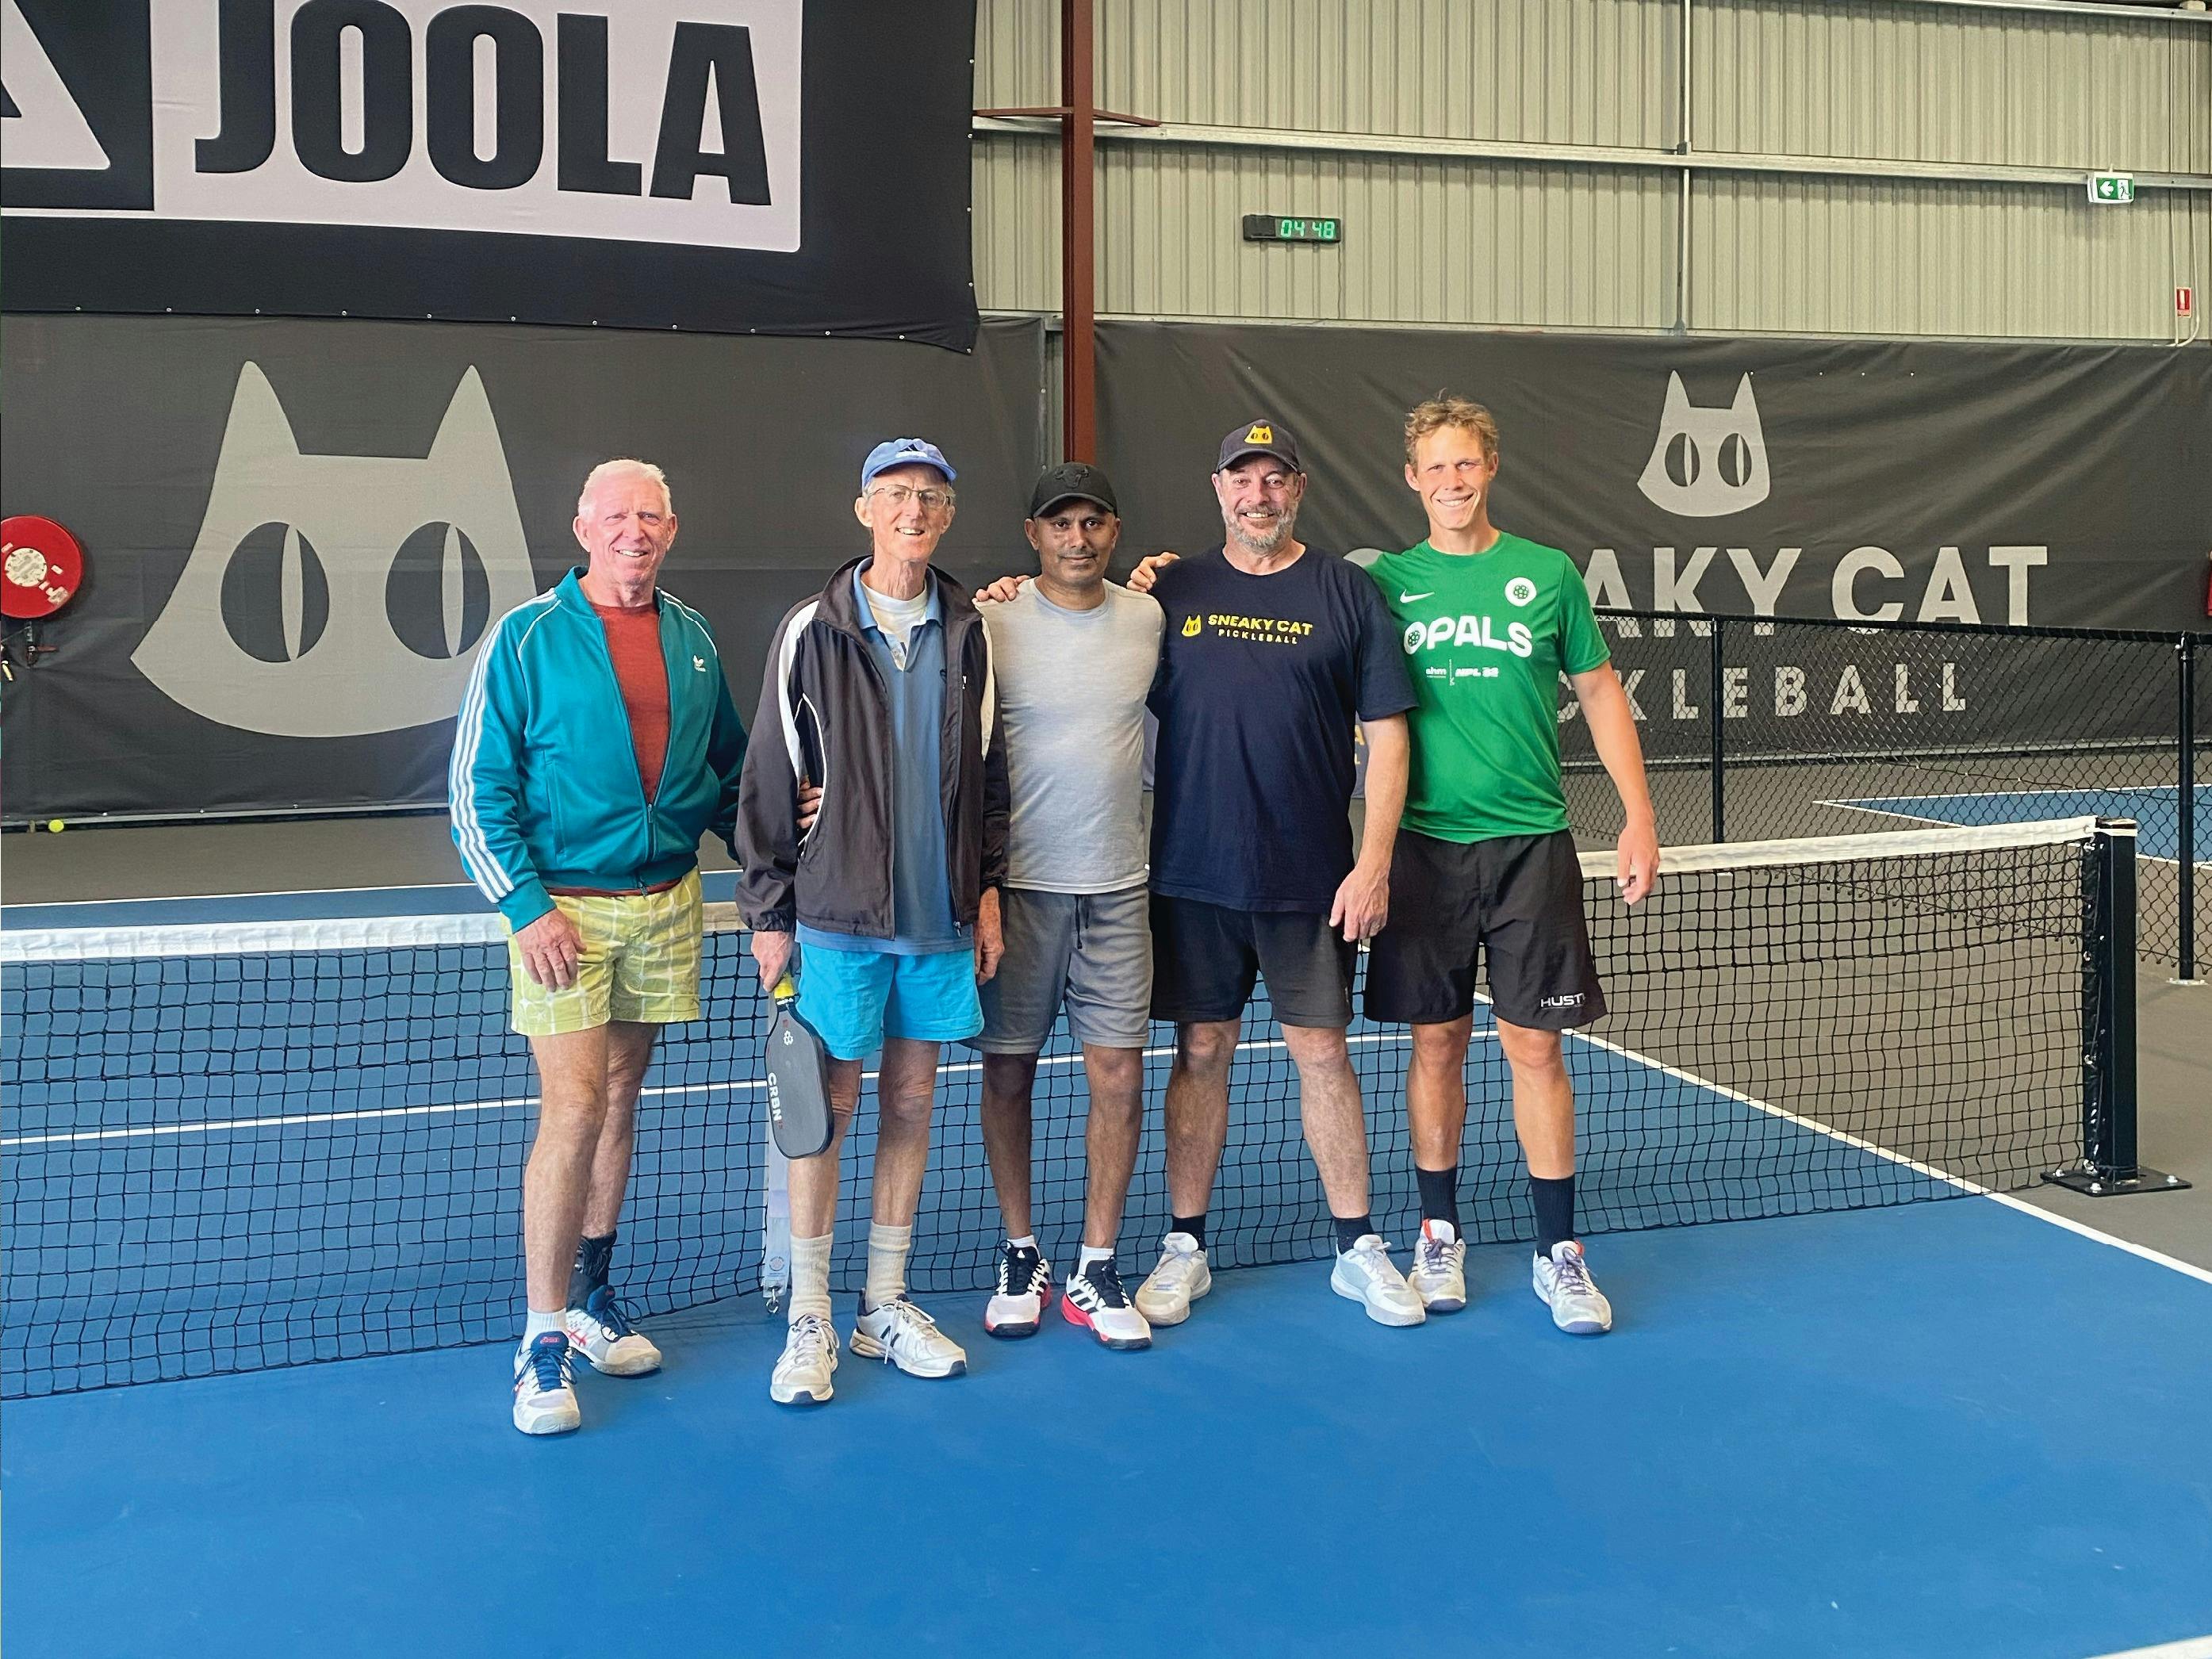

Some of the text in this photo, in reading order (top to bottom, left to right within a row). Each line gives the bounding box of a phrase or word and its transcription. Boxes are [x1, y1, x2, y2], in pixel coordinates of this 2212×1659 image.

[194, 0, 772, 206] JOOLA
[1831, 546, 2048, 634] CAT
[1208, 615, 1313, 636] SNEAKY CAT
[1218, 629, 1298, 645] PICKLEBALL
[1404, 615, 1533, 657] OPALS
[768, 1072, 782, 1121] CRBN
